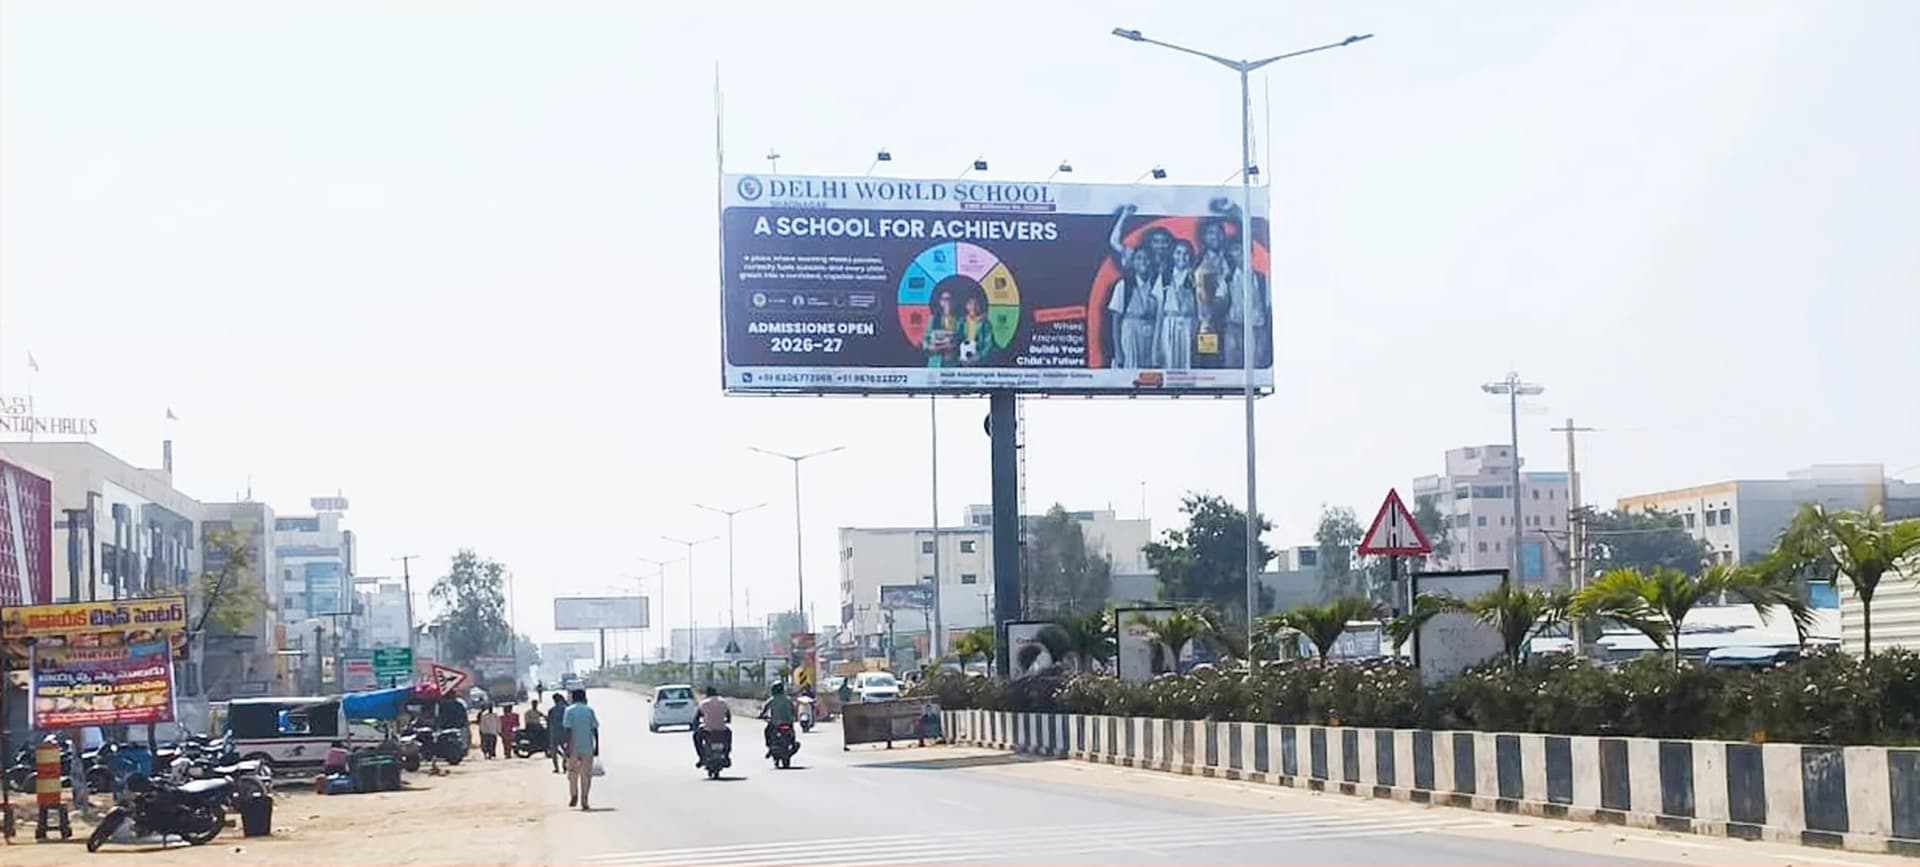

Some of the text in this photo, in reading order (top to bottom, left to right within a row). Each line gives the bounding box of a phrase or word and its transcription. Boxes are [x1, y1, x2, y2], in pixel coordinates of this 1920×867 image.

[770, 179, 1055, 203] DELHI WORLD SCHOOL
[754, 216, 1058, 240] A SCHOOL FOR ACHIEVERS
[748, 322, 876, 336] ADMISSIONS OPEN
[771, 338, 844, 353] 2026-27
[51, 417, 97, 434] HALLS
